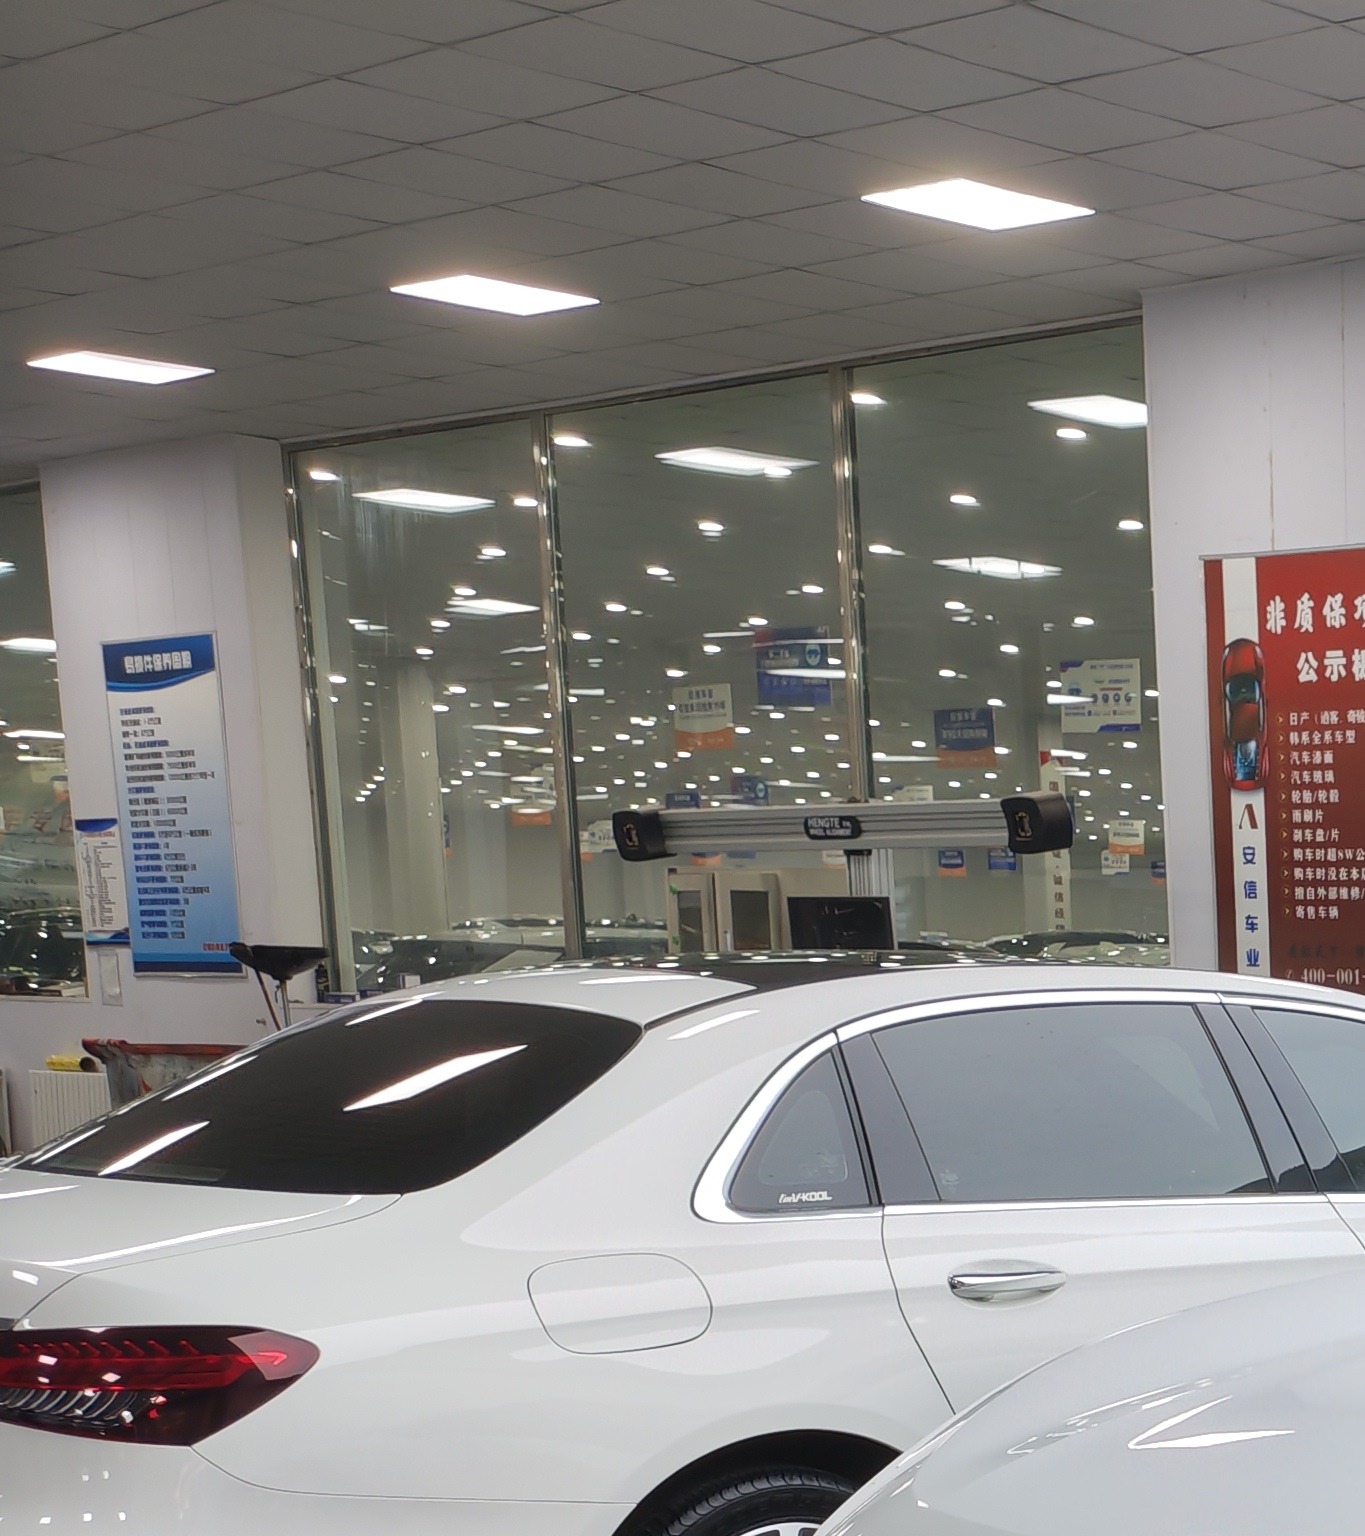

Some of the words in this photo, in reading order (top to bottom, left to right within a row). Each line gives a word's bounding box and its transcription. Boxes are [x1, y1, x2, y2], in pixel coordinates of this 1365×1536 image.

[1289, 730, 1356, 745] 韩系全系车型
[1290, 750, 1334, 765] 汽车漆面
[1291, 770, 1335, 784] 汽车玻璃
[1291, 789, 1340, 804] 轮胎/轮毂
[1292, 809, 1324, 823] 雨刷片
[1243, 846, 1260, 967] 安信车业
[1296, 905, 1339, 919] 寄售车辆
